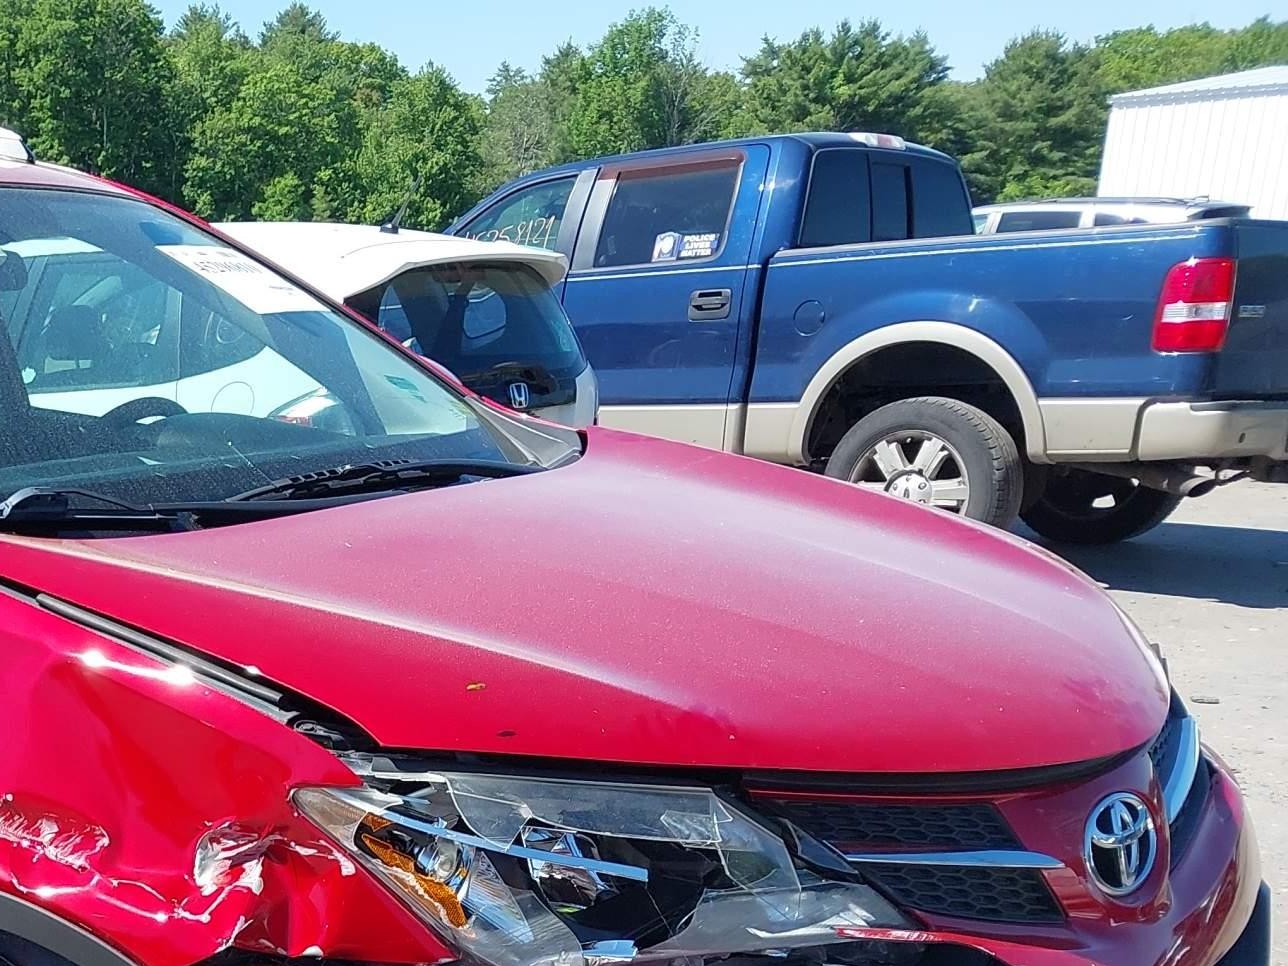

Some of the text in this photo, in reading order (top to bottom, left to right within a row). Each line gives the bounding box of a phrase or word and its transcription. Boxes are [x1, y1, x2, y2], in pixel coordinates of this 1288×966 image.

[683, 233, 716, 243] POLICE
[684, 241, 711, 250] LIVES
[679, 249, 712, 258] MATTER
